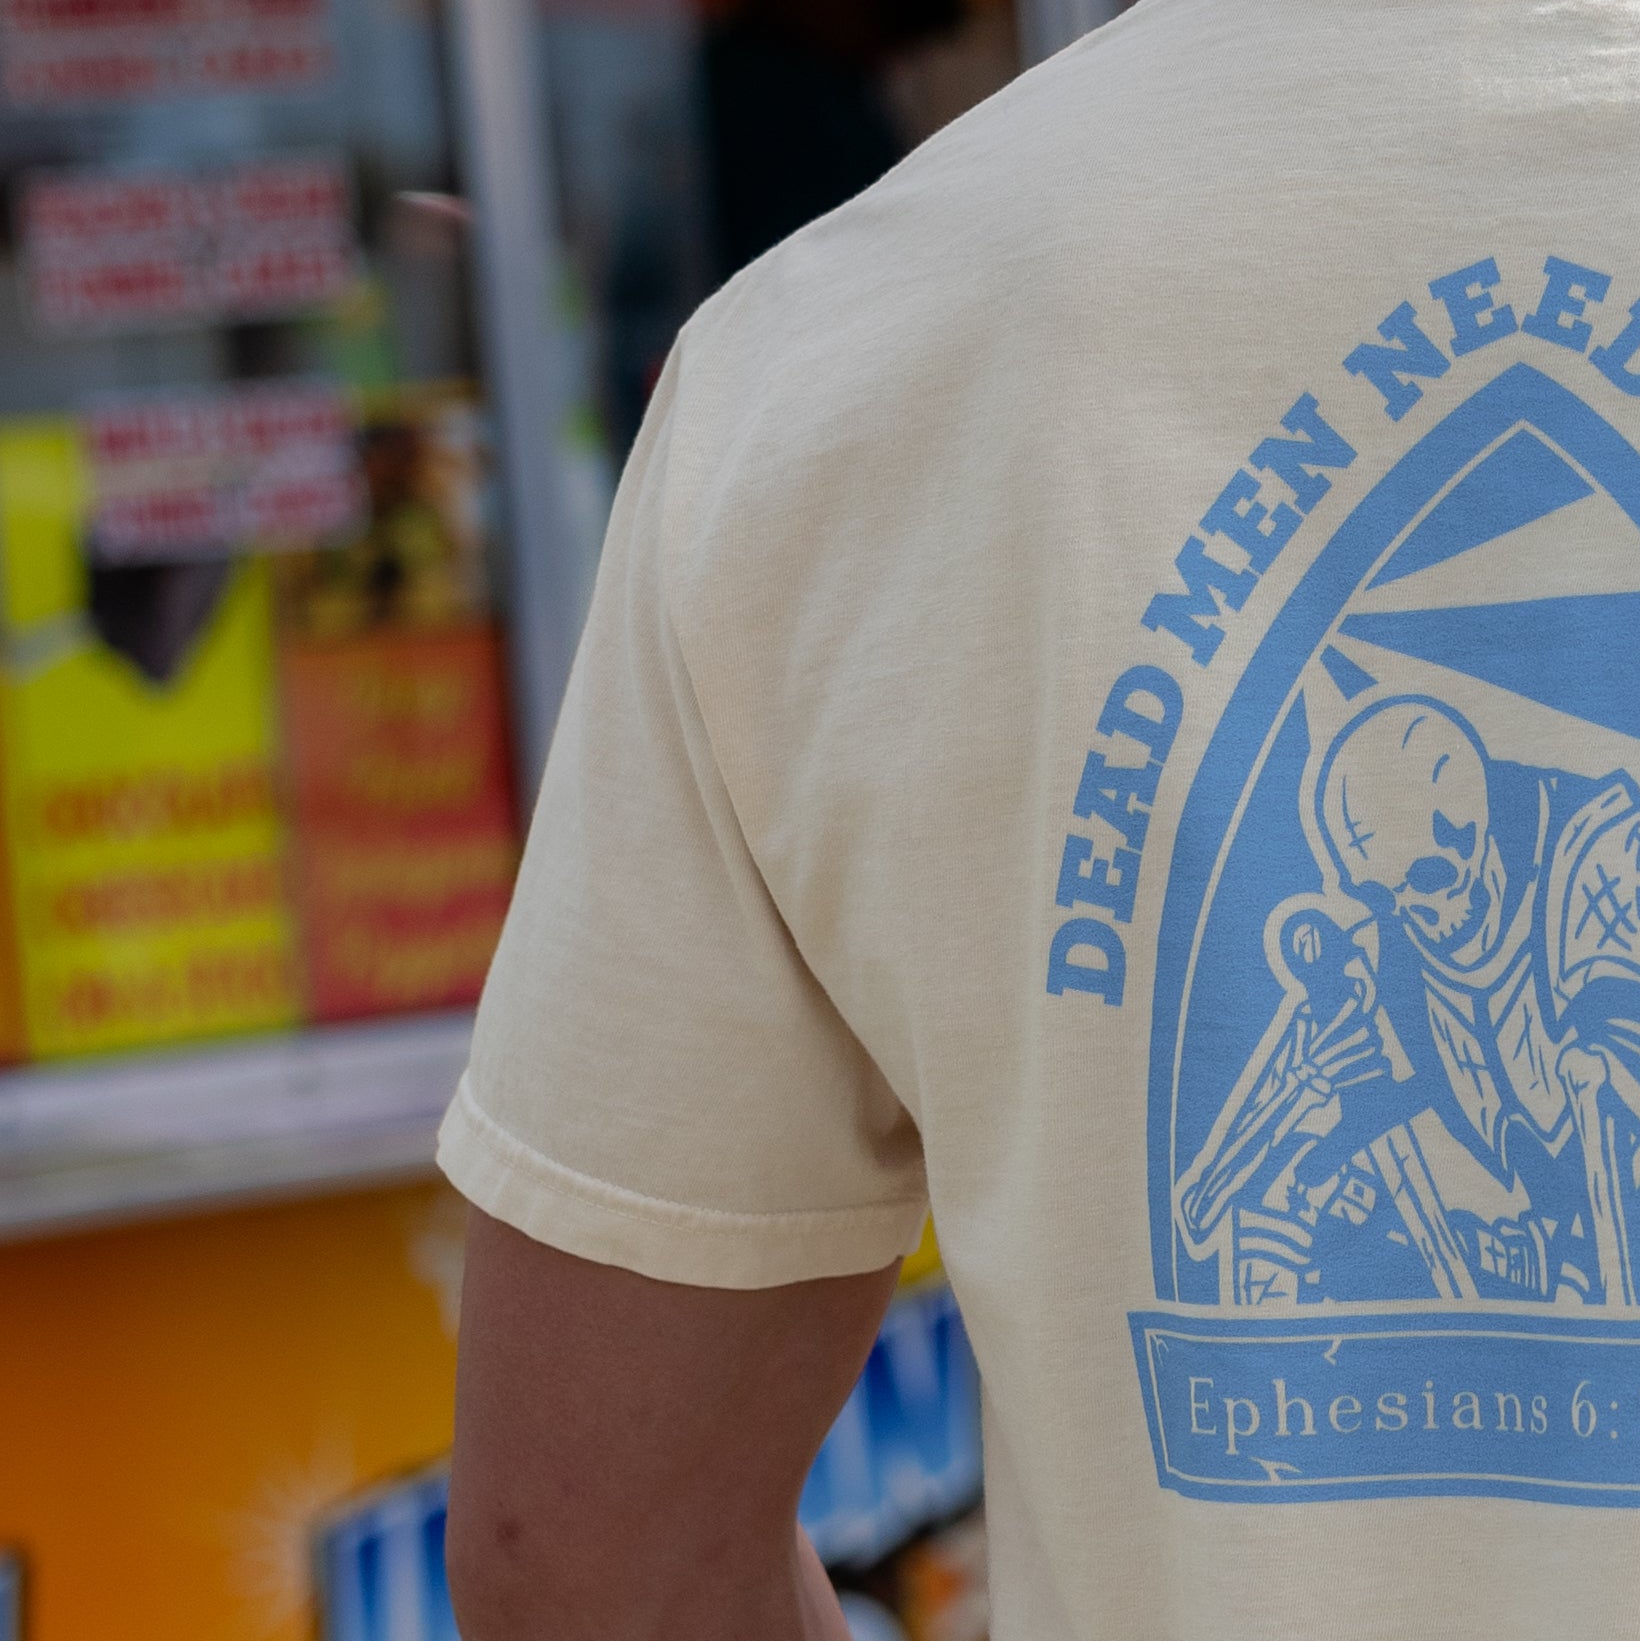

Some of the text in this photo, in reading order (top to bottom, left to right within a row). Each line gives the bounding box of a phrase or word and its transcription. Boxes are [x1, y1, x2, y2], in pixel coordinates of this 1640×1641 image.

[1045, 664, 1185, 1008] DEAD
[1140, 392, 1357, 667] MEN
[1189, 1376, 1549, 1456] Ephesians
